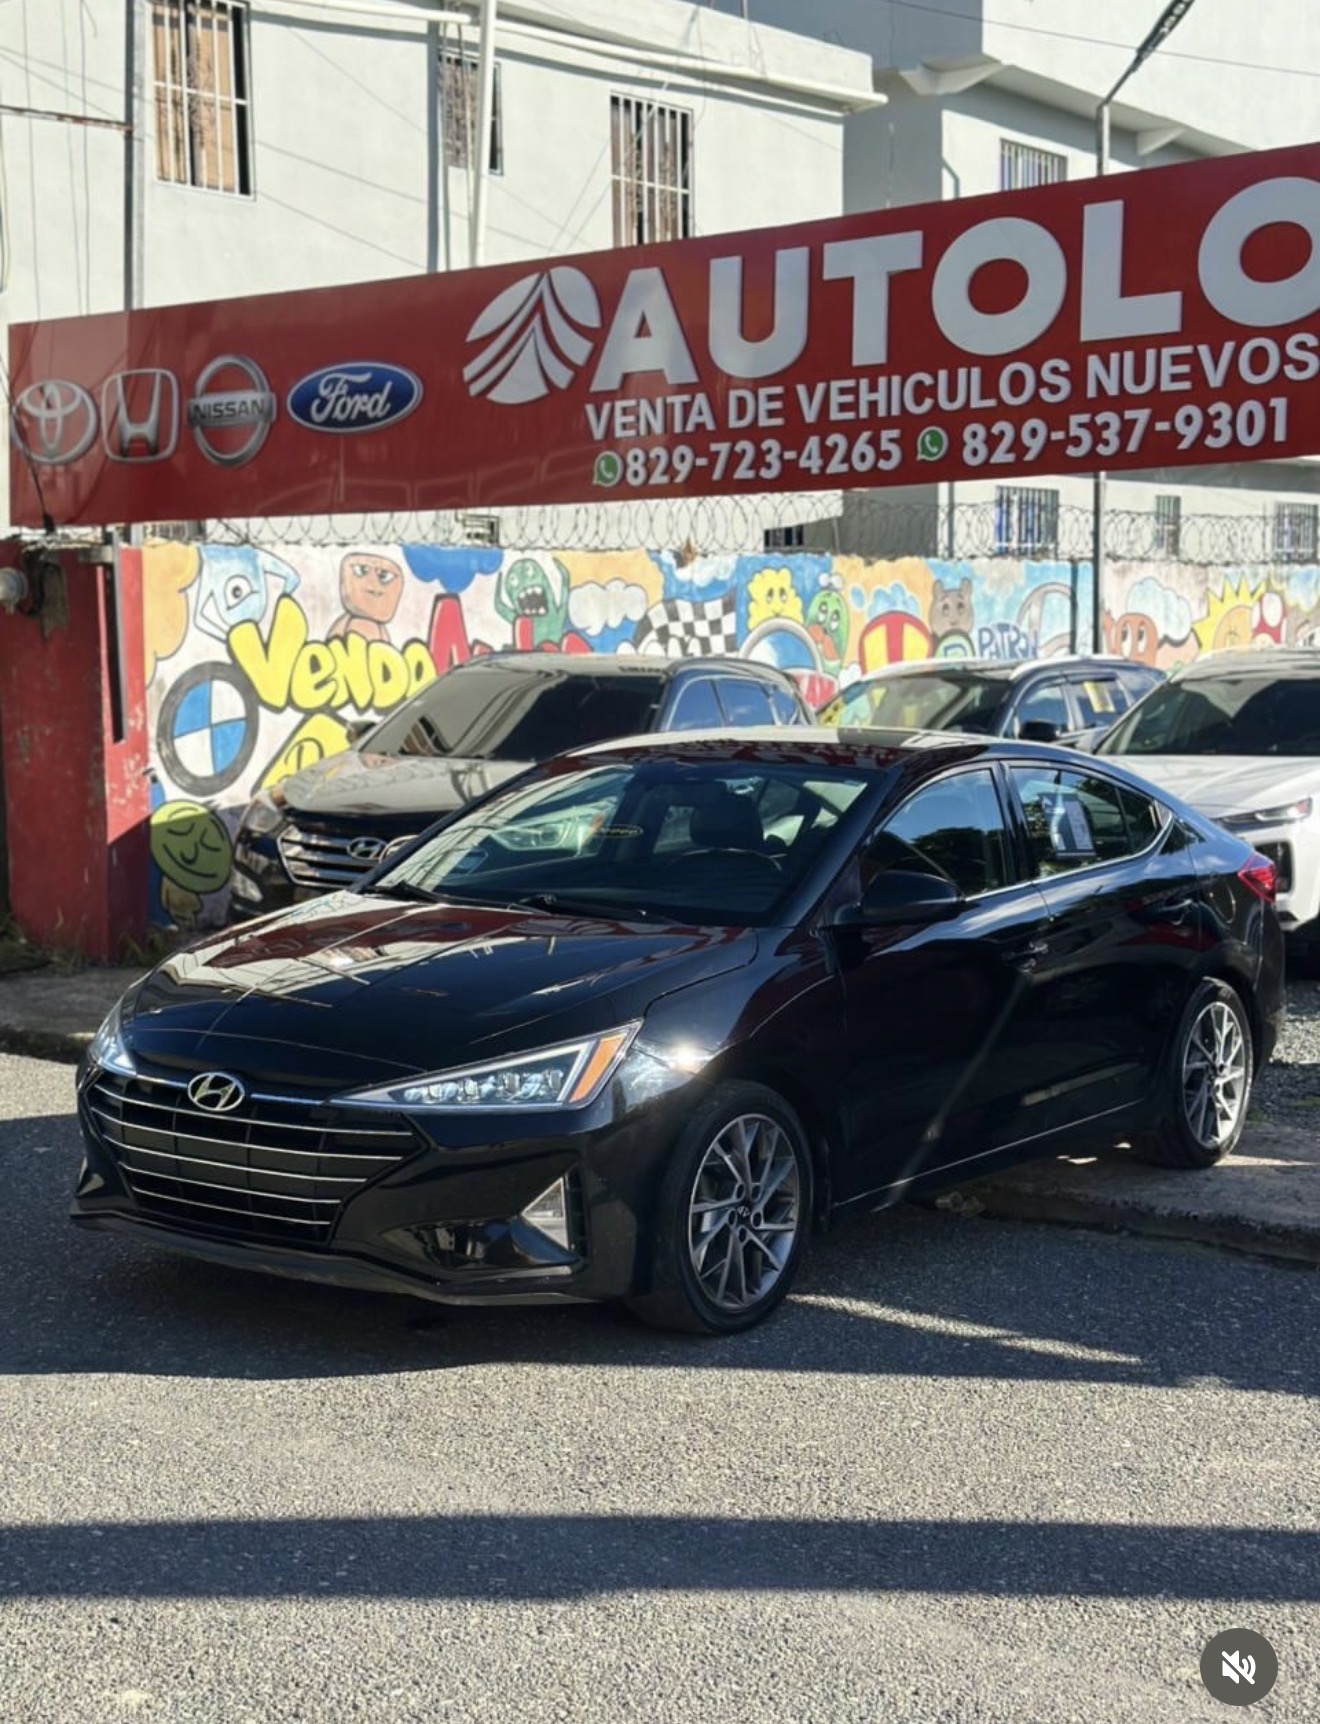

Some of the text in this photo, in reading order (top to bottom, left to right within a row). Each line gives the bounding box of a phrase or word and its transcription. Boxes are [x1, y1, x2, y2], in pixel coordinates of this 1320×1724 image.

[589, 176, 1320, 391] AUTOLO
[194, 400, 264, 420] NISSAN
[310, 372, 392, 423] Ford
[585, 333, 1320, 441] VENTA DE VEHICULOS NUEVOS
[625, 397, 1290, 487] 829-723-4265 829-537-9301
